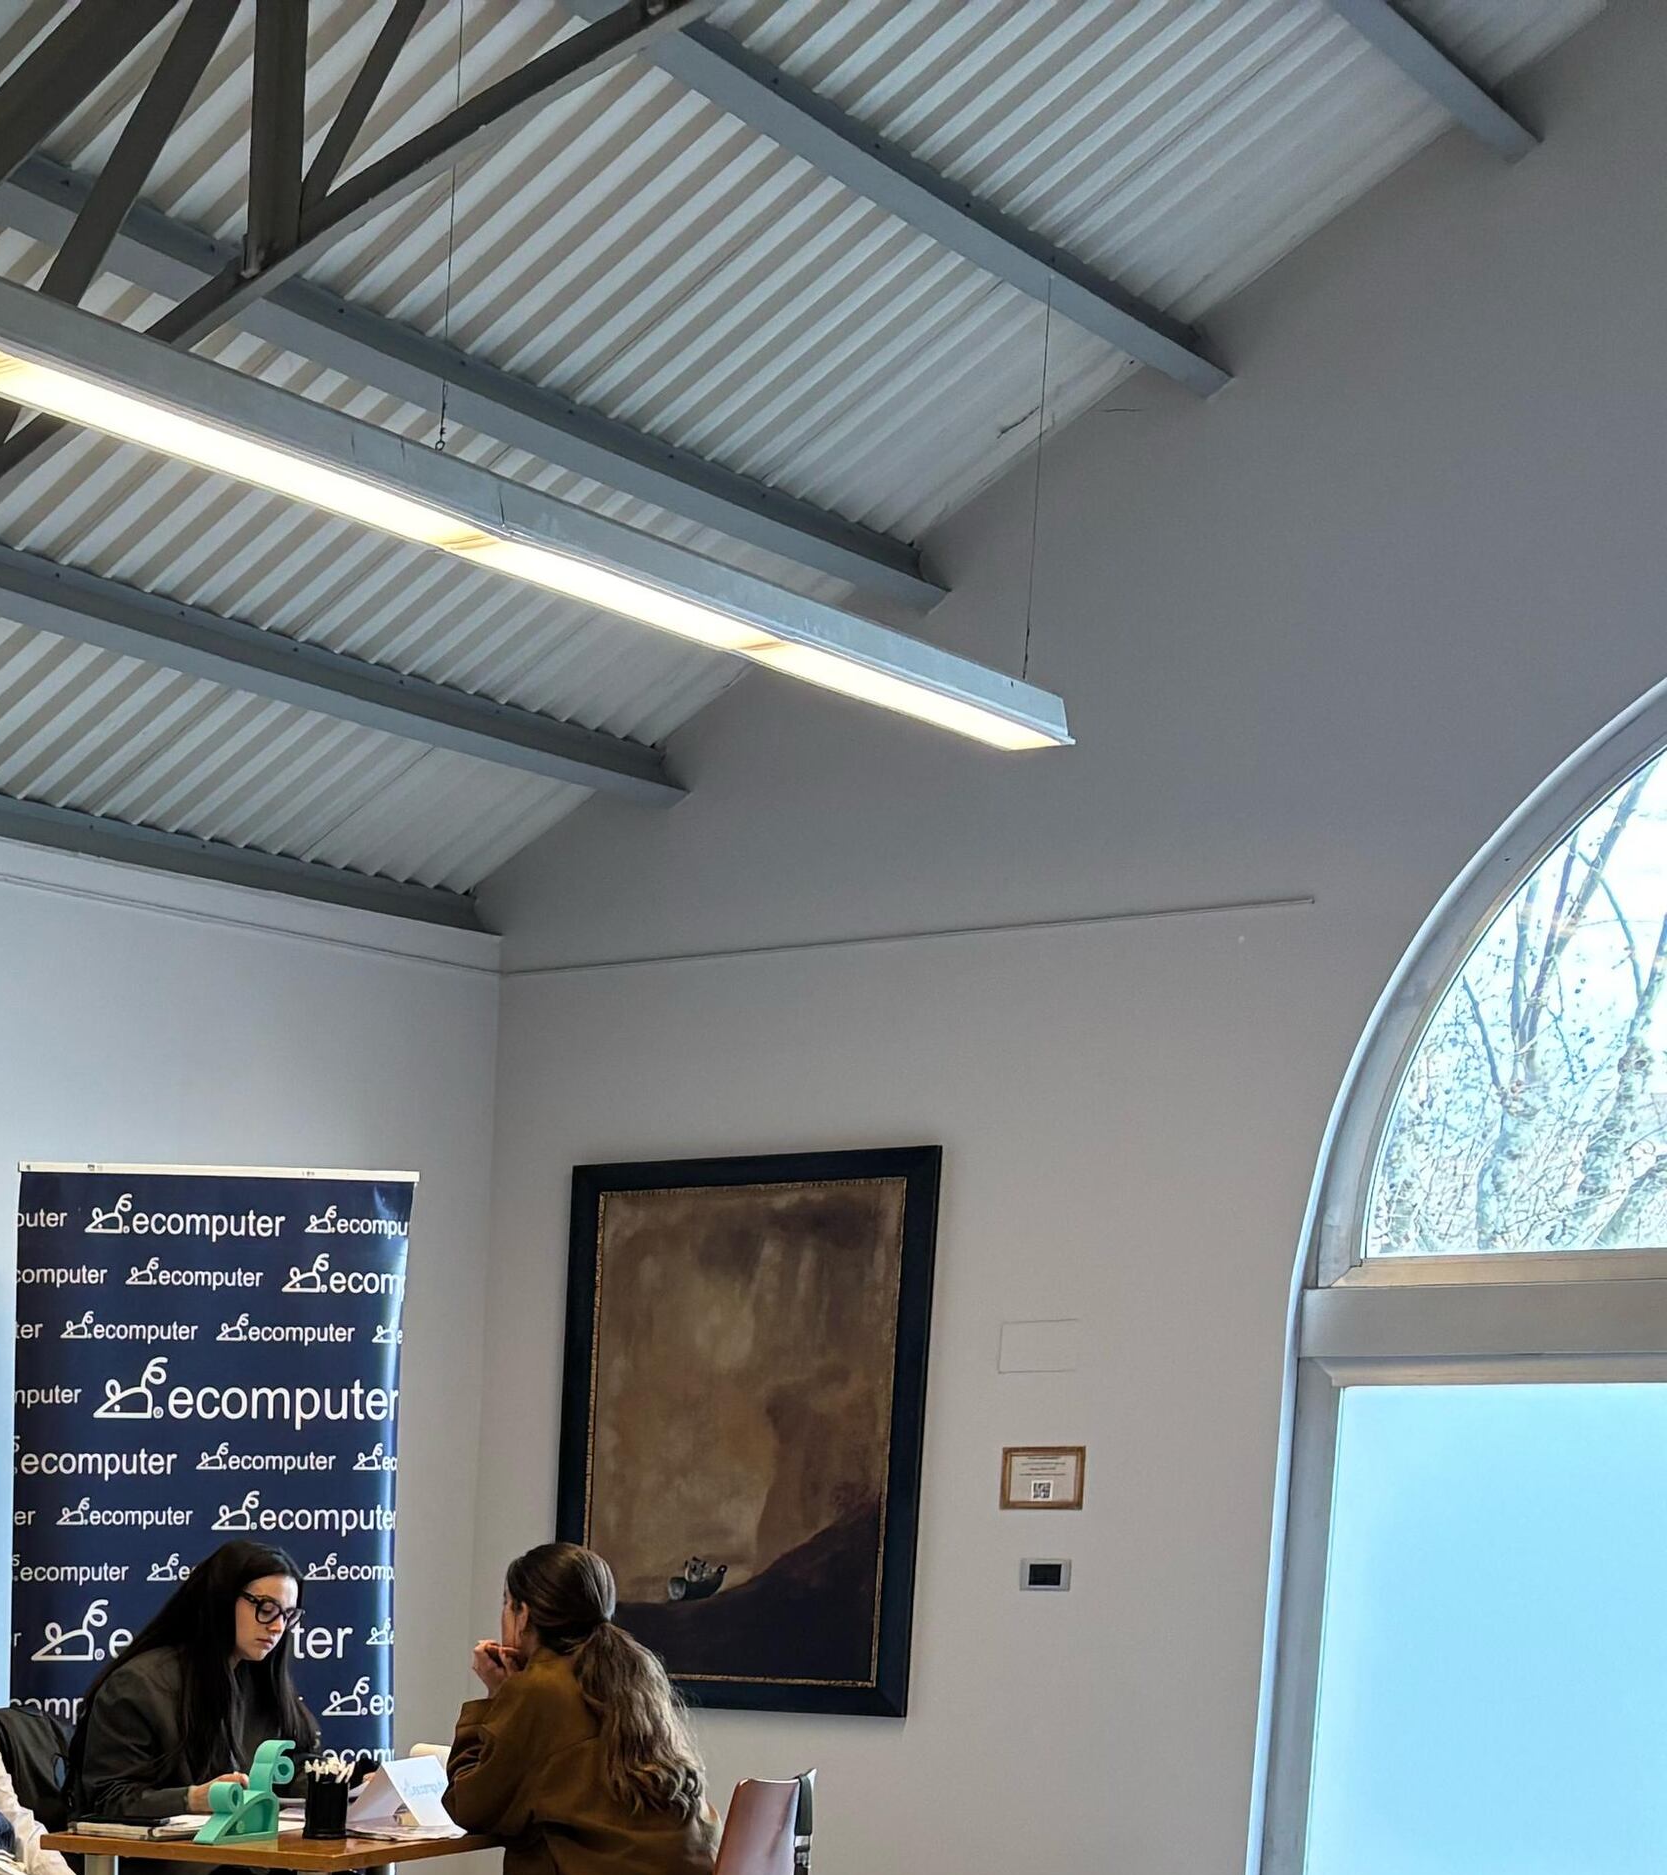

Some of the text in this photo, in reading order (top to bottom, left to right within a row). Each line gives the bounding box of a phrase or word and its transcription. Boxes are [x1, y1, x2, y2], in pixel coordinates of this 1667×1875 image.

[133, 1210, 285, 1242] ecomputer
[158, 1269, 263, 1292] ecomputer
[93, 1322, 198, 1346] ecomputer
[248, 1324, 355, 1347] ecomputer
[168, 1380, 398, 1430] ecomputer
[21, 1450, 178, 1487] ecomputer
[228, 1451, 336, 1475] ecomputer
[89, 1507, 193, 1531] ecomputer
[20, 1562, 128, 1586] ecomputer
